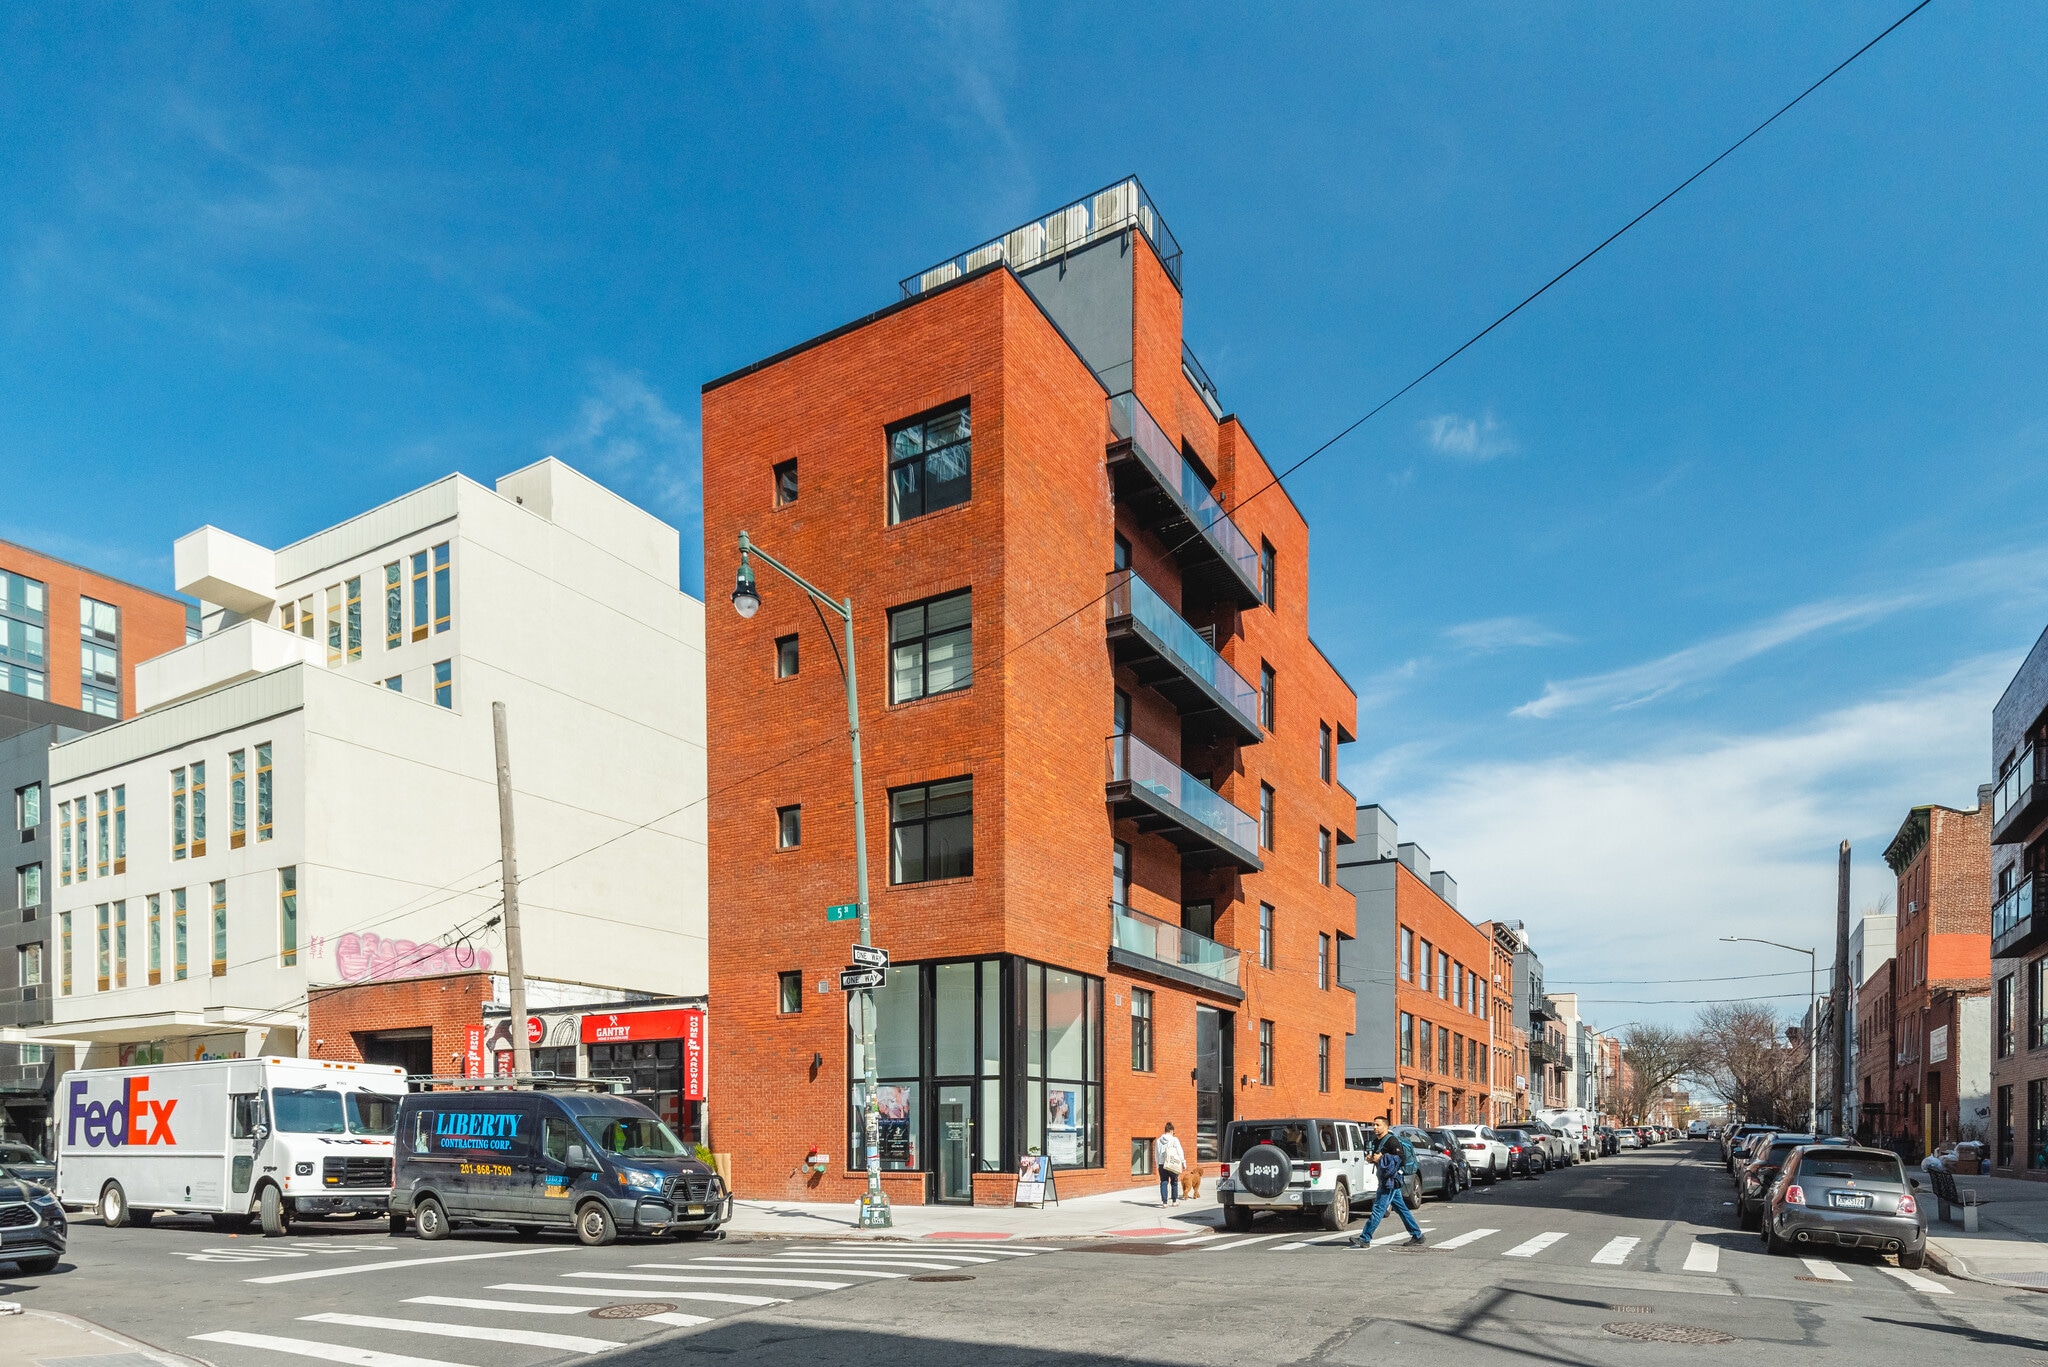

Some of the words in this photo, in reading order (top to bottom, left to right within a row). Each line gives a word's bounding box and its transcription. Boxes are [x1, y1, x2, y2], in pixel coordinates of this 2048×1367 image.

[837, 908, 842, 918] 5
[856, 951, 867, 960] ONE
[871, 953, 882, 961] WAY
[846, 975, 859, 984] ONE
[864, 974, 879, 982] WAY
[596, 1026, 631, 1037] GANTRY
[690, 1015, 699, 1038] HOME
[470, 1030, 479, 1051] HOME
[690, 1051, 699, 1095] HARDWARE
[68, 1076, 178, 1147] FedEx
[436, 1113, 523, 1137] LIBERTY
[440, 1138, 489, 1150] CONTRACTING
[489, 1139, 512, 1150] CORP.
[460, 1164, 512, 1176] 201-868-7500
